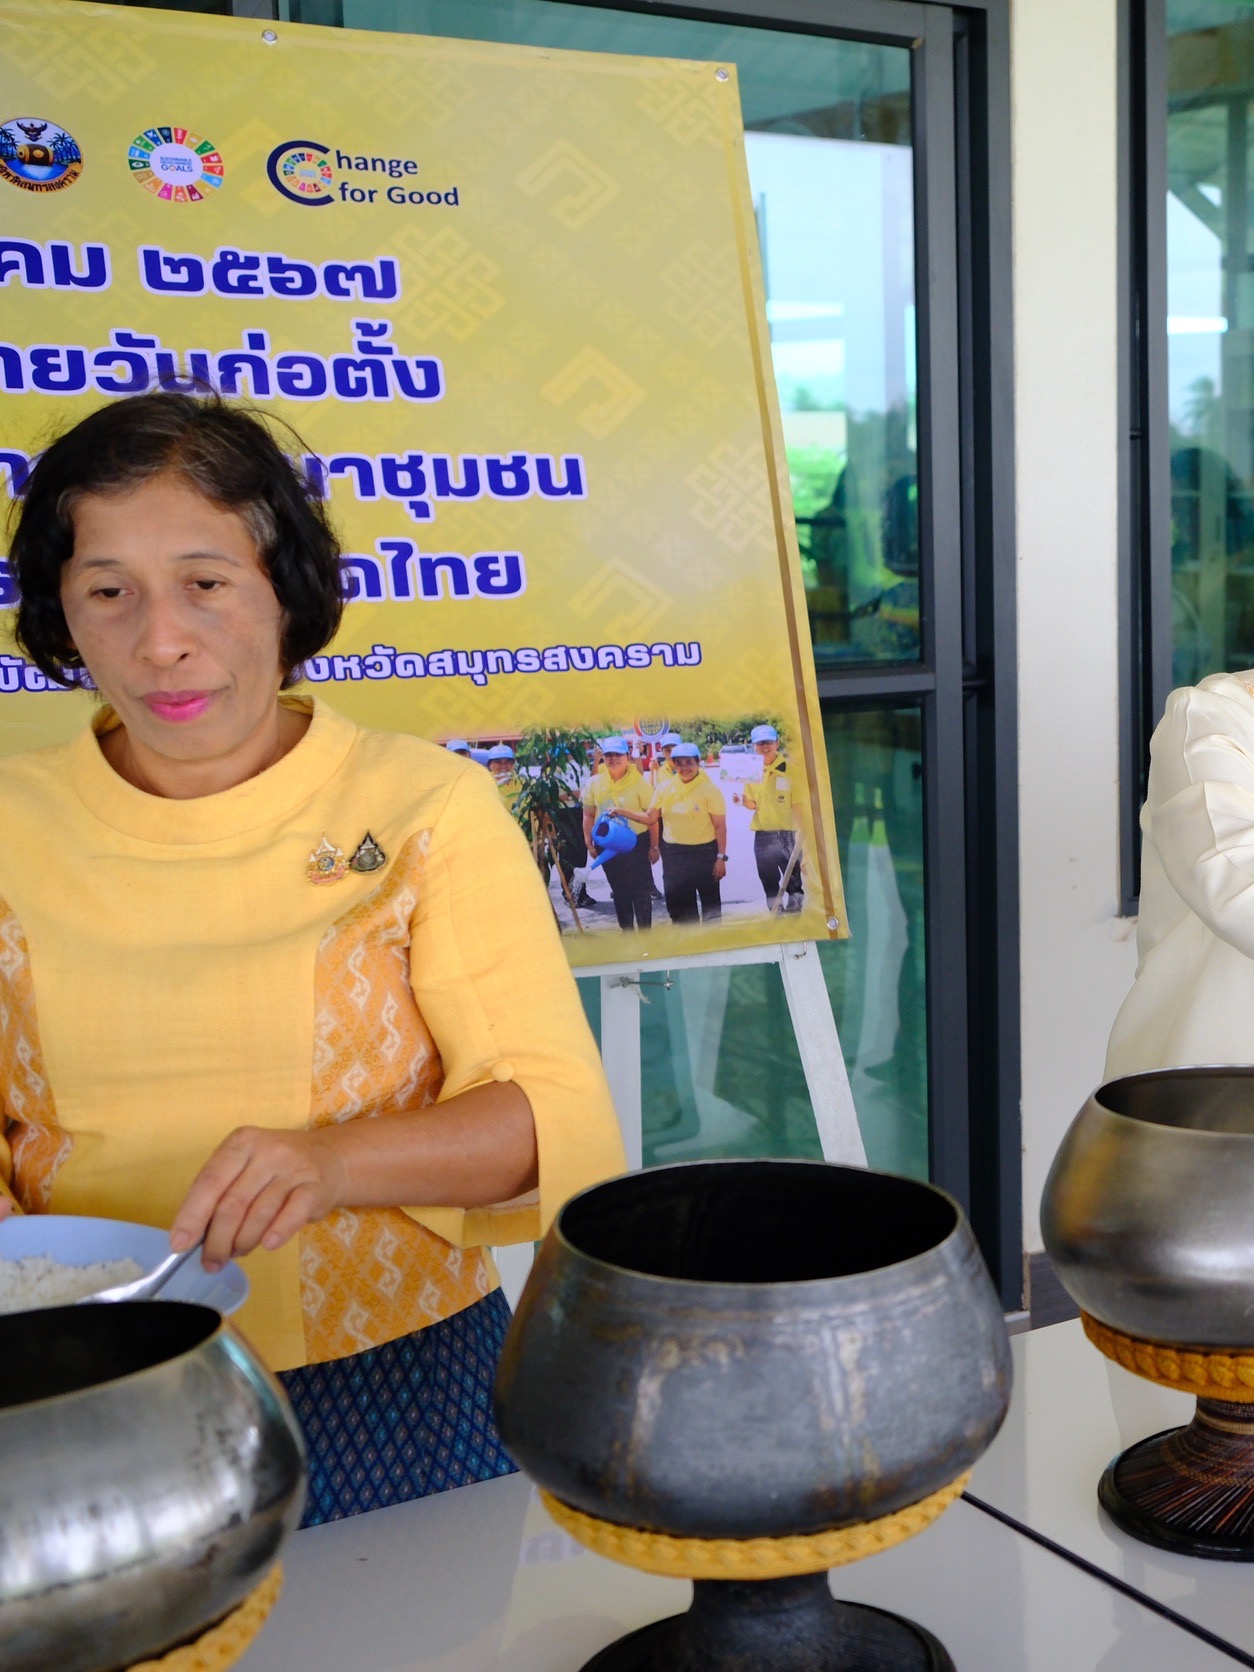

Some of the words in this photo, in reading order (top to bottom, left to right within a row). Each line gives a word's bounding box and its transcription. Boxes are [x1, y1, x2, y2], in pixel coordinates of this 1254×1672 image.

[339, 182, 378, 203] for
[387, 186, 459, 206] Good
[142, 249, 399, 301] ๒๕๖๗
[300, 642, 702, 686] งหวัดสมุทรสงคราม
